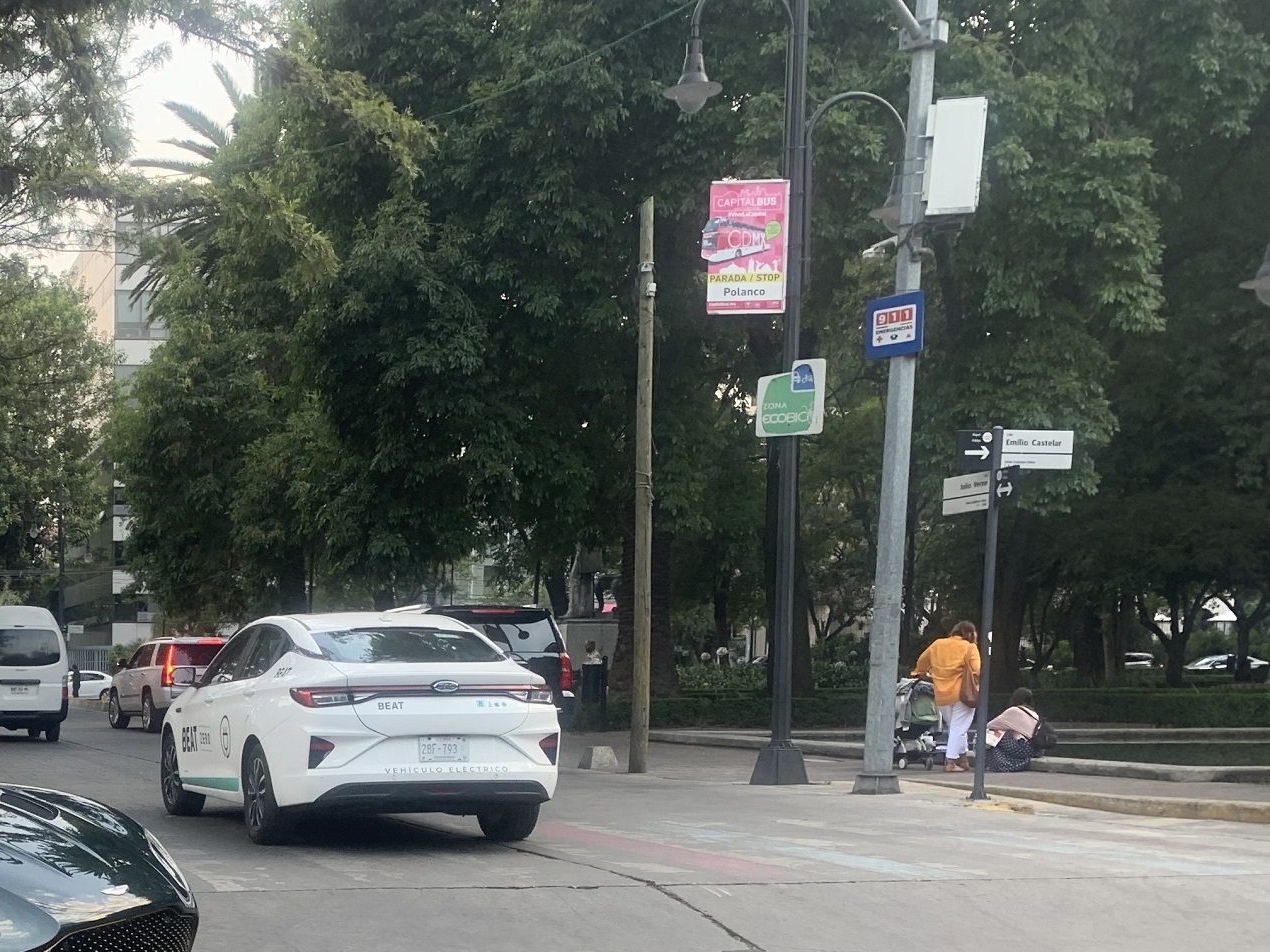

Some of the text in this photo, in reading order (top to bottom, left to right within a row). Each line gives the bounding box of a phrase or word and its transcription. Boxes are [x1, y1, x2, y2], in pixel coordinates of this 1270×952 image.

[717, 197, 777, 207] CAPITALBUS
[727, 229, 766, 248] CDMX
[709, 274, 747, 282] PARADA
[756, 273, 780, 282] STOP
[723, 287, 765, 296] Polanco
[878, 309, 910, 325] 911
[875, 325, 913, 335] EMERGENCIAS
[763, 402, 787, 410] ZONA
[1031, 439, 1062, 447] Castelar
[377, 701, 404, 710] BEAT
[182, 726, 198, 752] BEAT
[449, 765, 508, 773] ELÉCTRICO
